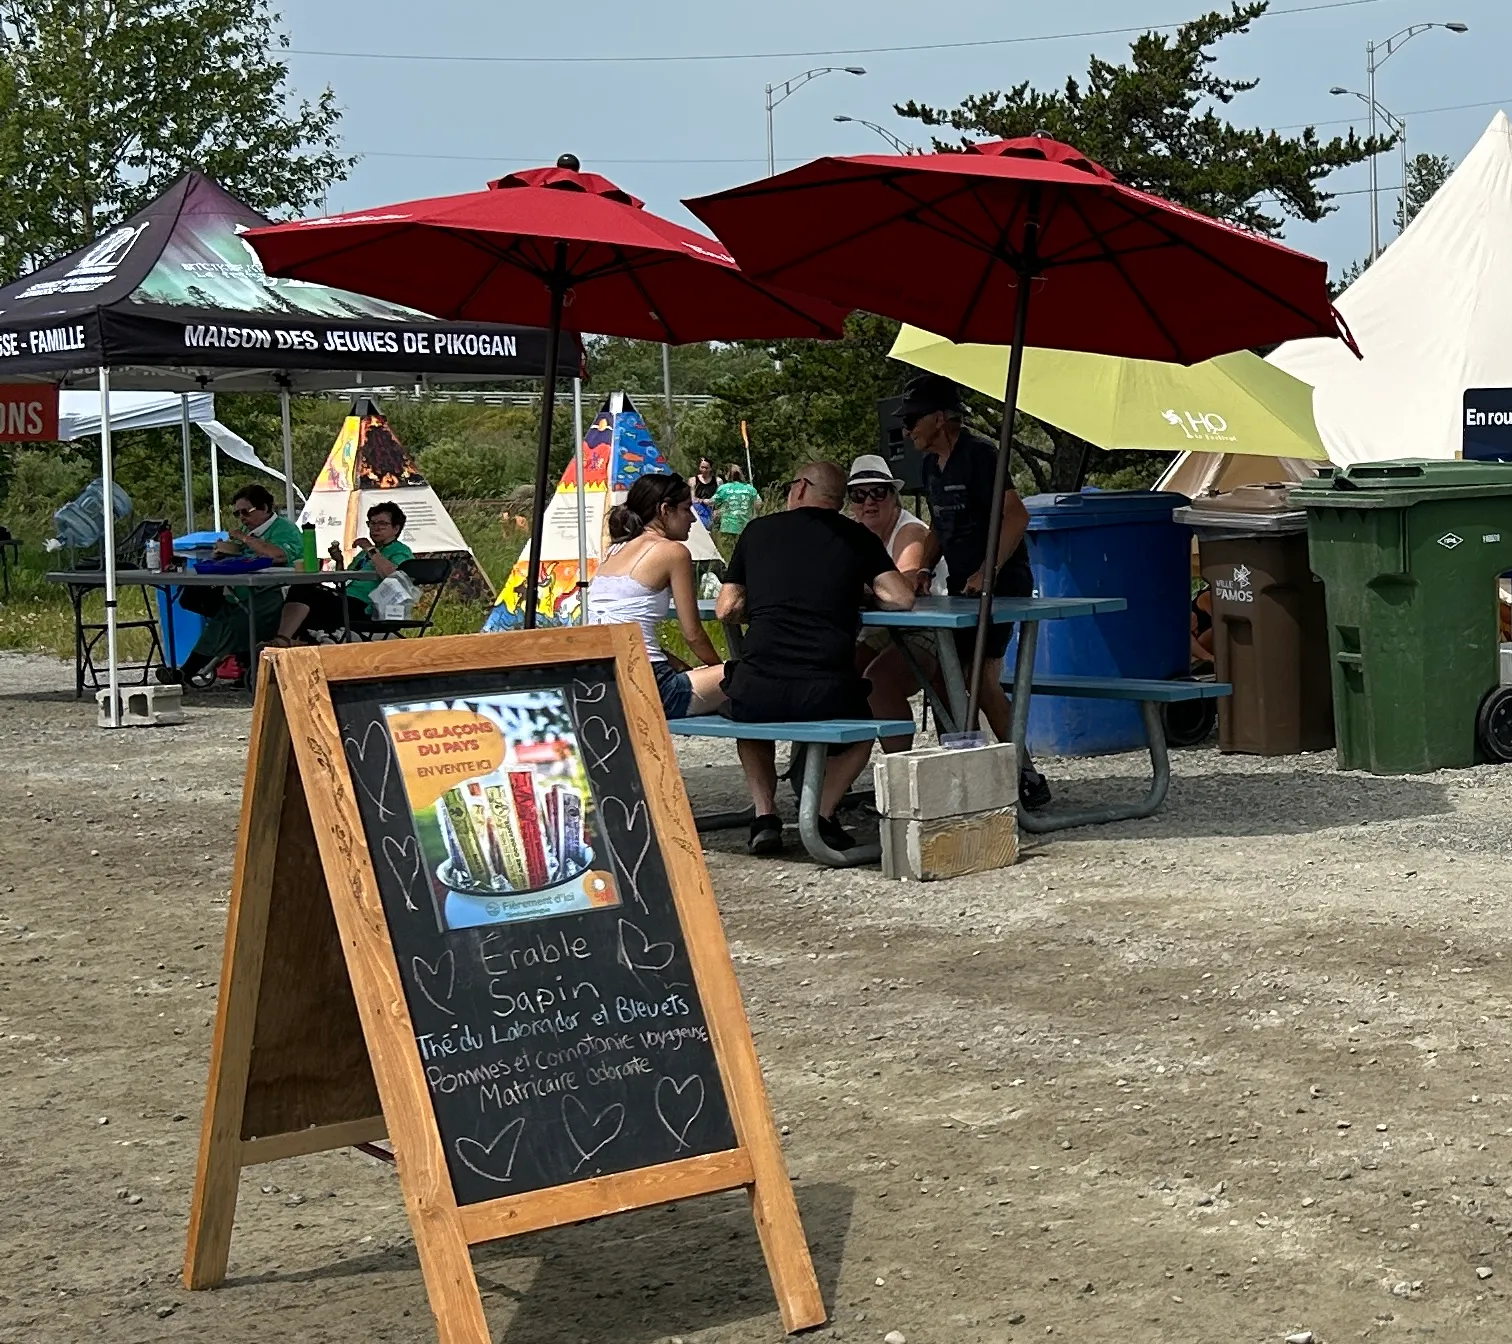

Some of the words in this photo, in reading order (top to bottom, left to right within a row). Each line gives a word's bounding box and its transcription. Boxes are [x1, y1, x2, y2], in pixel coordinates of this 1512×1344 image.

[30, 325, 86, 354] FAMILLE
[183, 324, 271, 349] MAISON
[274, 329, 318, 350] DES
[323, 331, 399, 354] JEUNES
[403, 332, 430, 354] DE
[434, 333, 517, 357] PIKOGAN
[1466, 409, 1486, 426] En
[1215, 579, 1234, 589] VILLE
[1215, 587, 1254, 603] D'AMOS
[394, 728, 421, 743] LES
[423, 721, 494, 740] GLAÇONS
[417, 744, 441, 757] DU
[443, 739, 481, 755] PAYS
[416, 767, 437, 778] EN
[437, 761, 476, 777] VENTE
[477, 759, 492, 771] ICI
[480, 931, 592, 976] Érable
[489, 976, 600, 1017] Sapin
[416, 1023, 457, 1060] Thé
[459, 1025, 483, 1050] du
[491, 1009, 581, 1044] Labrador
[591, 1003, 609, 1026] et
[616, 993, 690, 1024] Bleuets
[425, 1058, 512, 1094] Pommes
[514, 1048, 532, 1071] et
[639, 1025, 709, 1052] voyageuse
[479, 1071, 580, 1113] Matricaire
